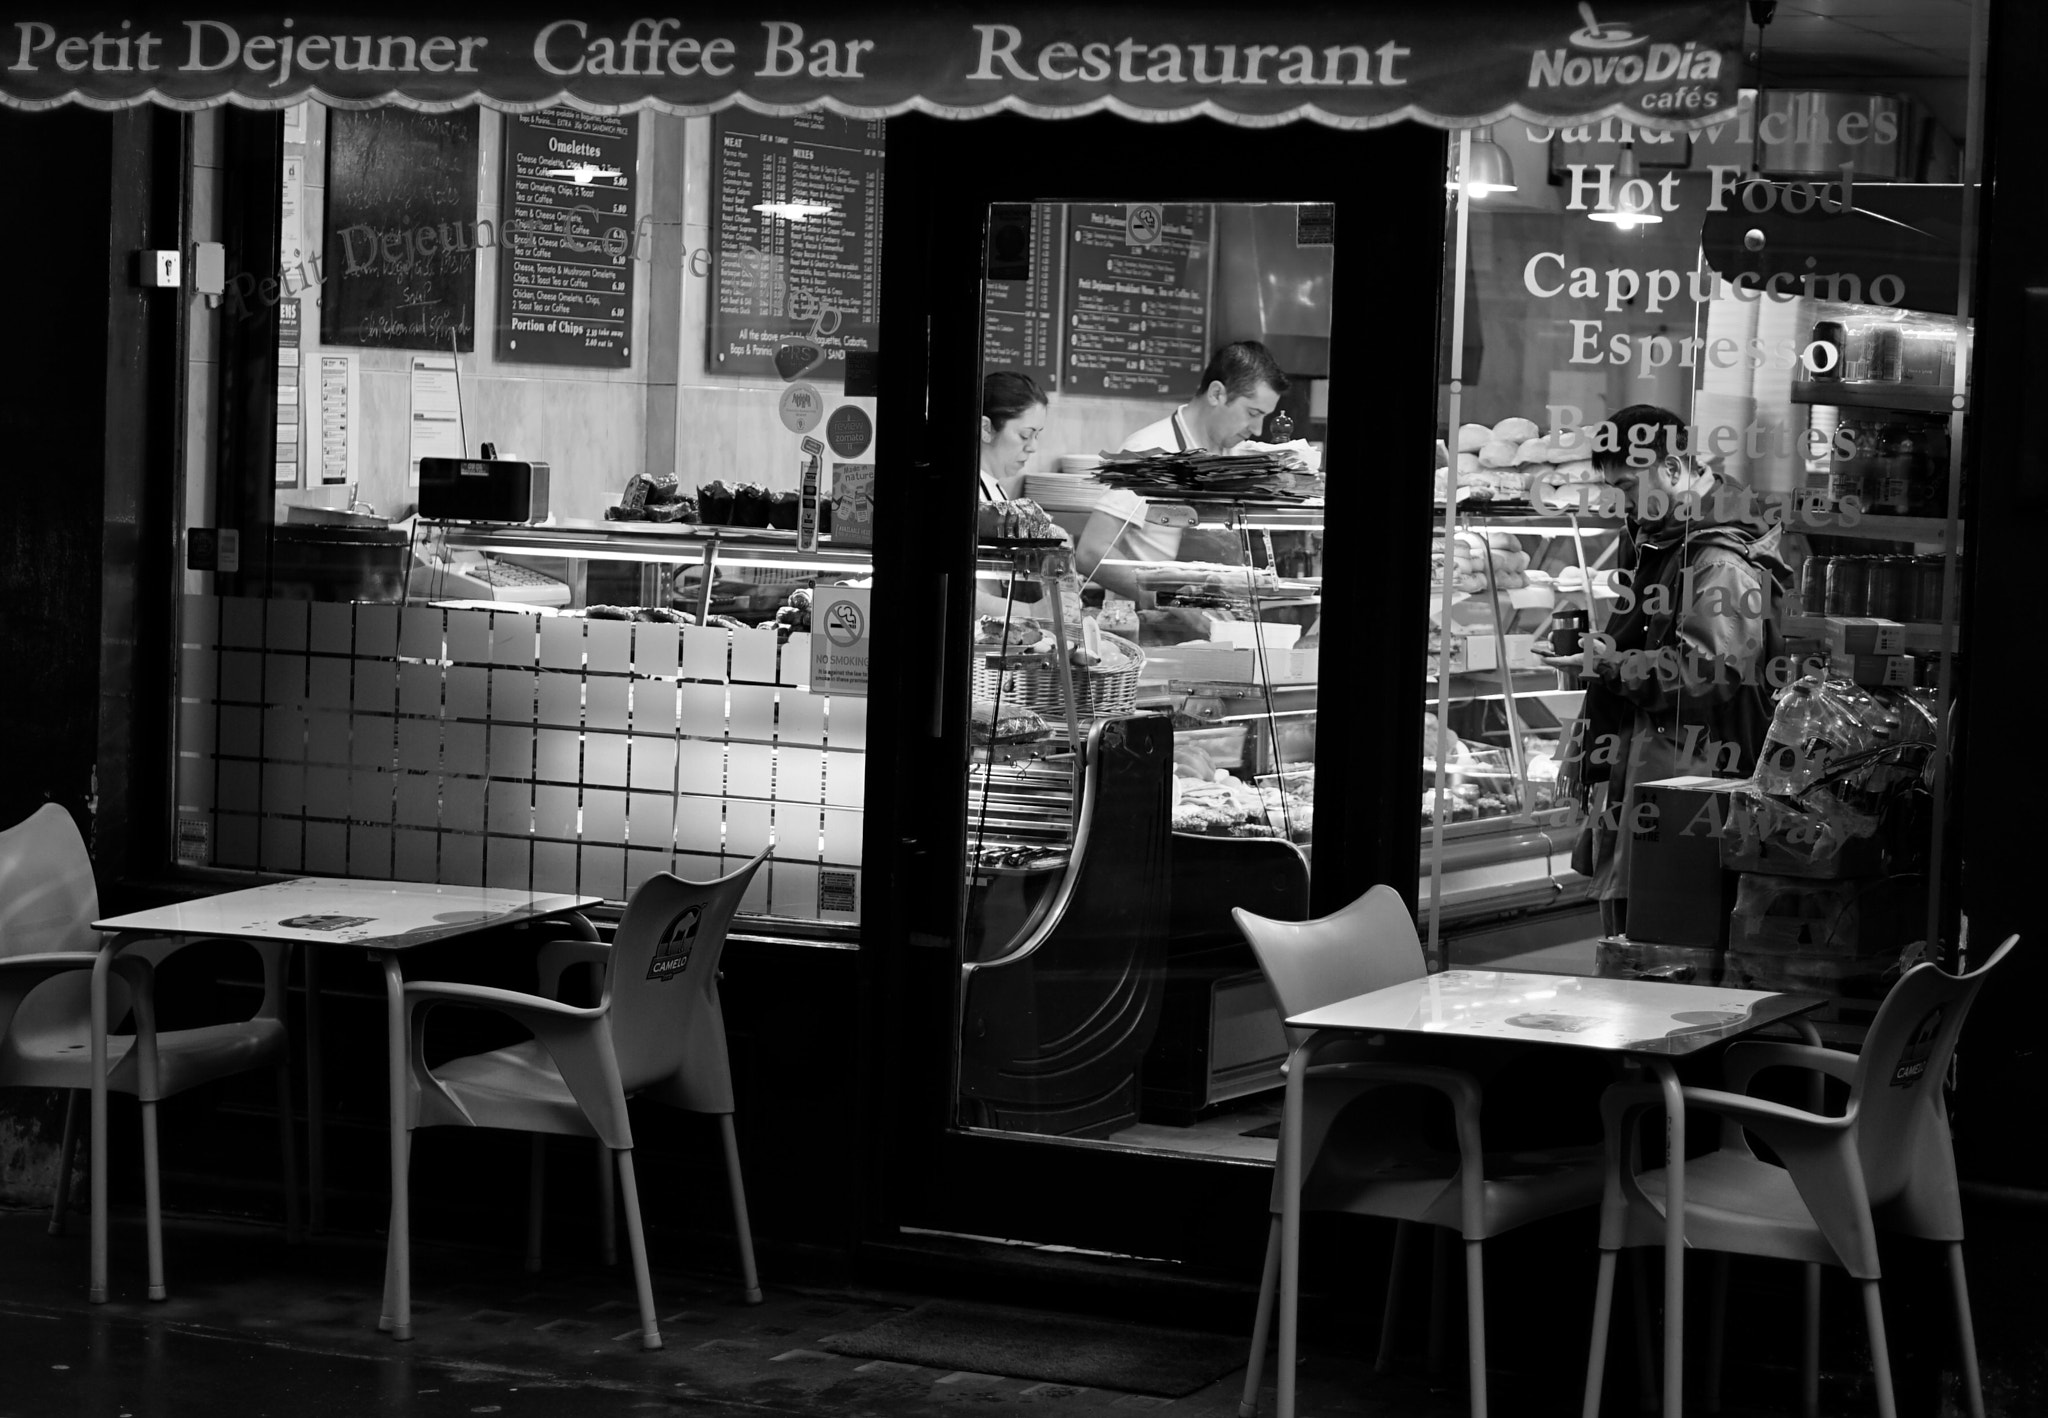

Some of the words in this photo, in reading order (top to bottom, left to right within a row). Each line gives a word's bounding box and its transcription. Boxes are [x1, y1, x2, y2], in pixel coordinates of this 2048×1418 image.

[7, 18, 162, 72] Petit
[177, 16, 489, 88] Dejeuner
[533, 17, 736, 76] Caffee
[754, 21, 875, 78] Bar
[966, 24, 1411, 86] Restaurant
[1527, 42, 1722, 88] NovoDia
[1640, 86, 1719, 110] cafés
[583, 123, 592, 131] ON
[548, 137, 601, 157] Omelettes
[723, 137, 743, 149] MEAT
[516, 153, 537, 164] Cheese
[792, 148, 815, 160] MIXES
[516, 164, 526, 174] Tea
[515, 181, 529, 190] Ham
[575, 187, 579, 195] 2
[580, 188, 595, 198] Toast
[1565, 164, 1682, 212] Hot
[1706, 160, 1855, 214] Food
[515, 192, 525, 201] Tea
[534, 194, 553, 205] Coffee
[514, 208, 528, 216] Ham
[530, 209, 534, 217] &
[535, 210, 555, 220] Cheese
[554, 224, 563, 232] Tea
[571, 225, 590, 235] Coffee
[532, 237, 537, 245] &
[538, 237, 558, 248] Cheese
[514, 246, 524, 255] Tea
[533, 248, 551, 258] Coffee
[224, 250, 329, 322] Petit
[337, 213, 541, 275] Dejeuner
[513, 262, 535, 273] Cheese,
[536, 263, 556, 274] Tomato
[557, 266, 561, 274] &
[563, 267, 591, 277] Mushroom
[513, 273, 529, 285] Chips,
[531, 275, 535, 283] 2
[537, 275, 551, 285] Toast
[552, 275, 561, 285] Tea
[570, 278, 588, 288] Coffee
[1078, 278, 1092, 289] Petit
[1092, 279, 1115, 292] Dejeuner
[1523, 251, 1906, 313] Cappuccino
[512, 289, 535, 302] Chicken,
[536, 290, 557, 301] Cheese
[585, 294, 601, 306] Chips,
[512, 300, 517, 310] 2
[518, 300, 532, 310] Toast
[533, 302, 543, 311] Tea
[551, 303, 570, 314] Coffee
[511, 317, 545, 332] Portion
[547, 320, 556, 333] of
[558, 320, 584, 337] Chips
[598, 328, 610, 336] take
[611, 330, 624, 339] away
[739, 328, 748, 340] All
[749, 329, 759, 341] the
[607, 339, 613, 348] in
[730, 343, 745, 357] Baps
[746, 344, 751, 355] &
[752, 343, 773, 357] Paninis
[1568, 319, 1840, 379] Espresso
[834, 421, 864, 430] review
[835, 433, 864, 442] zomato
[1545, 404, 1858, 468] Baguettes
[845, 471, 875, 482] nature
[816, 654, 829, 664] NO
[830, 655, 869, 667] SMOKING
[1579, 633, 1826, 691] Pastries
[1550, 717, 1653, 768] Eat
[1676, 724, 1743, 774] In
[1513, 779, 1661, 835] Take
[1678, 792, 1854, 862] Away
[652, 956, 688, 973] CAMELO
